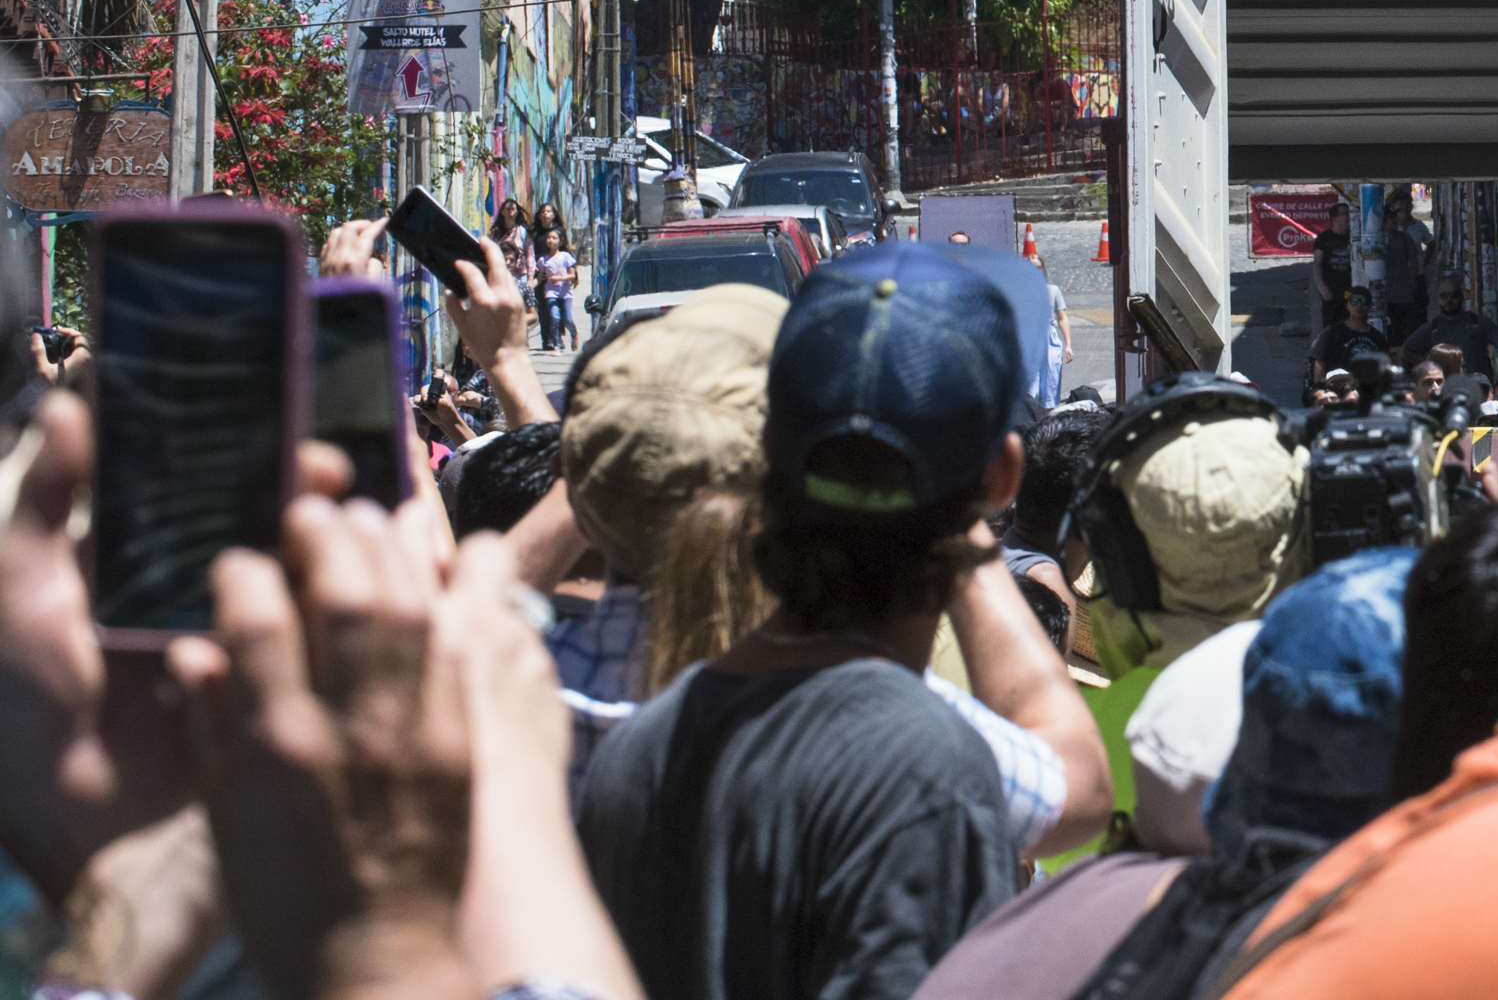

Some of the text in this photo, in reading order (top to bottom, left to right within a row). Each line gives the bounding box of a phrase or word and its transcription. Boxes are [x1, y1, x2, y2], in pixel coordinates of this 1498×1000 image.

[383, 27, 408, 36] SALTO
[409, 27, 436, 36] HOTEL
[11, 151, 170, 176] AMAPOLA
